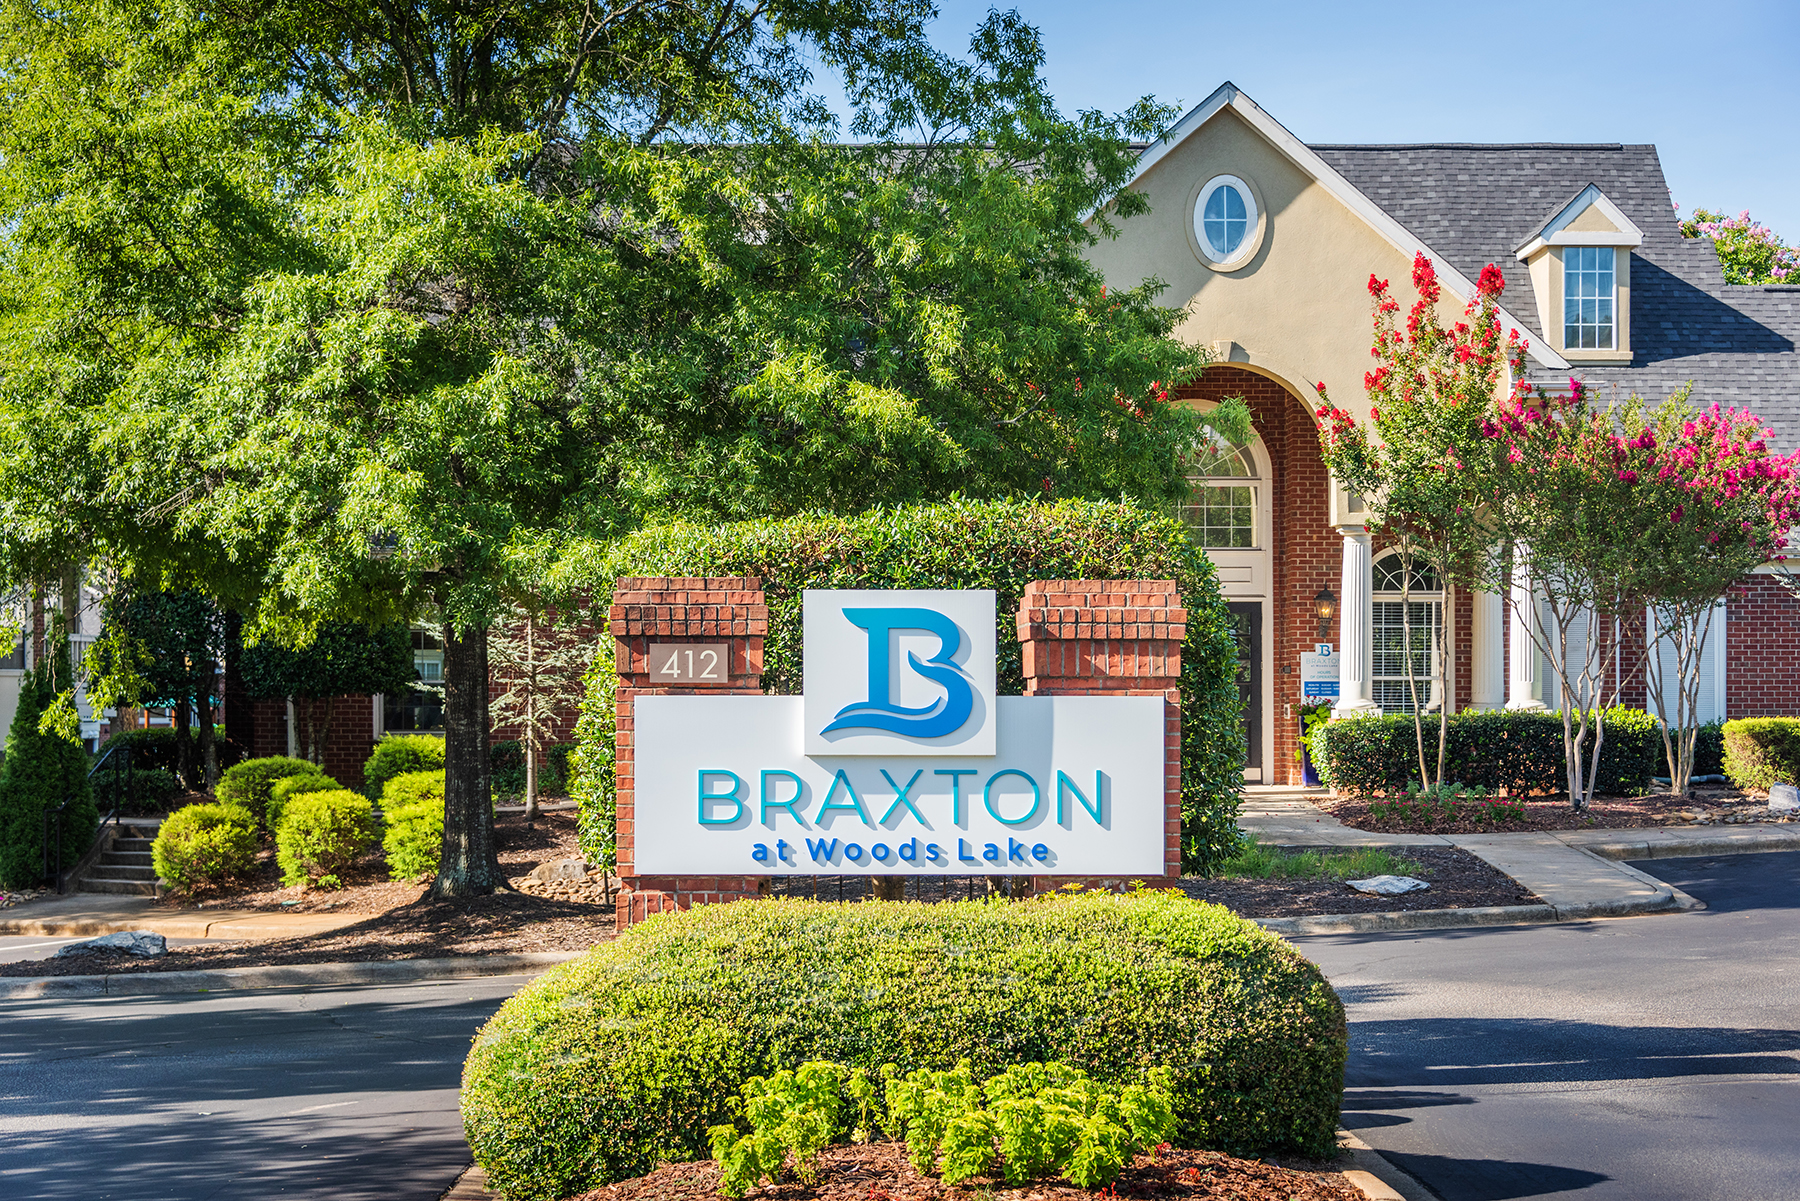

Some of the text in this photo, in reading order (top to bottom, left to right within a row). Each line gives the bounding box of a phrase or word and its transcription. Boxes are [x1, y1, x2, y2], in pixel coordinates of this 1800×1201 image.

[660, 649, 718, 678] 412
[820, 608, 974, 739] B
[698, 769, 1102, 824] BRAXTON
[752, 837, 1049, 862] at Woods Lake
